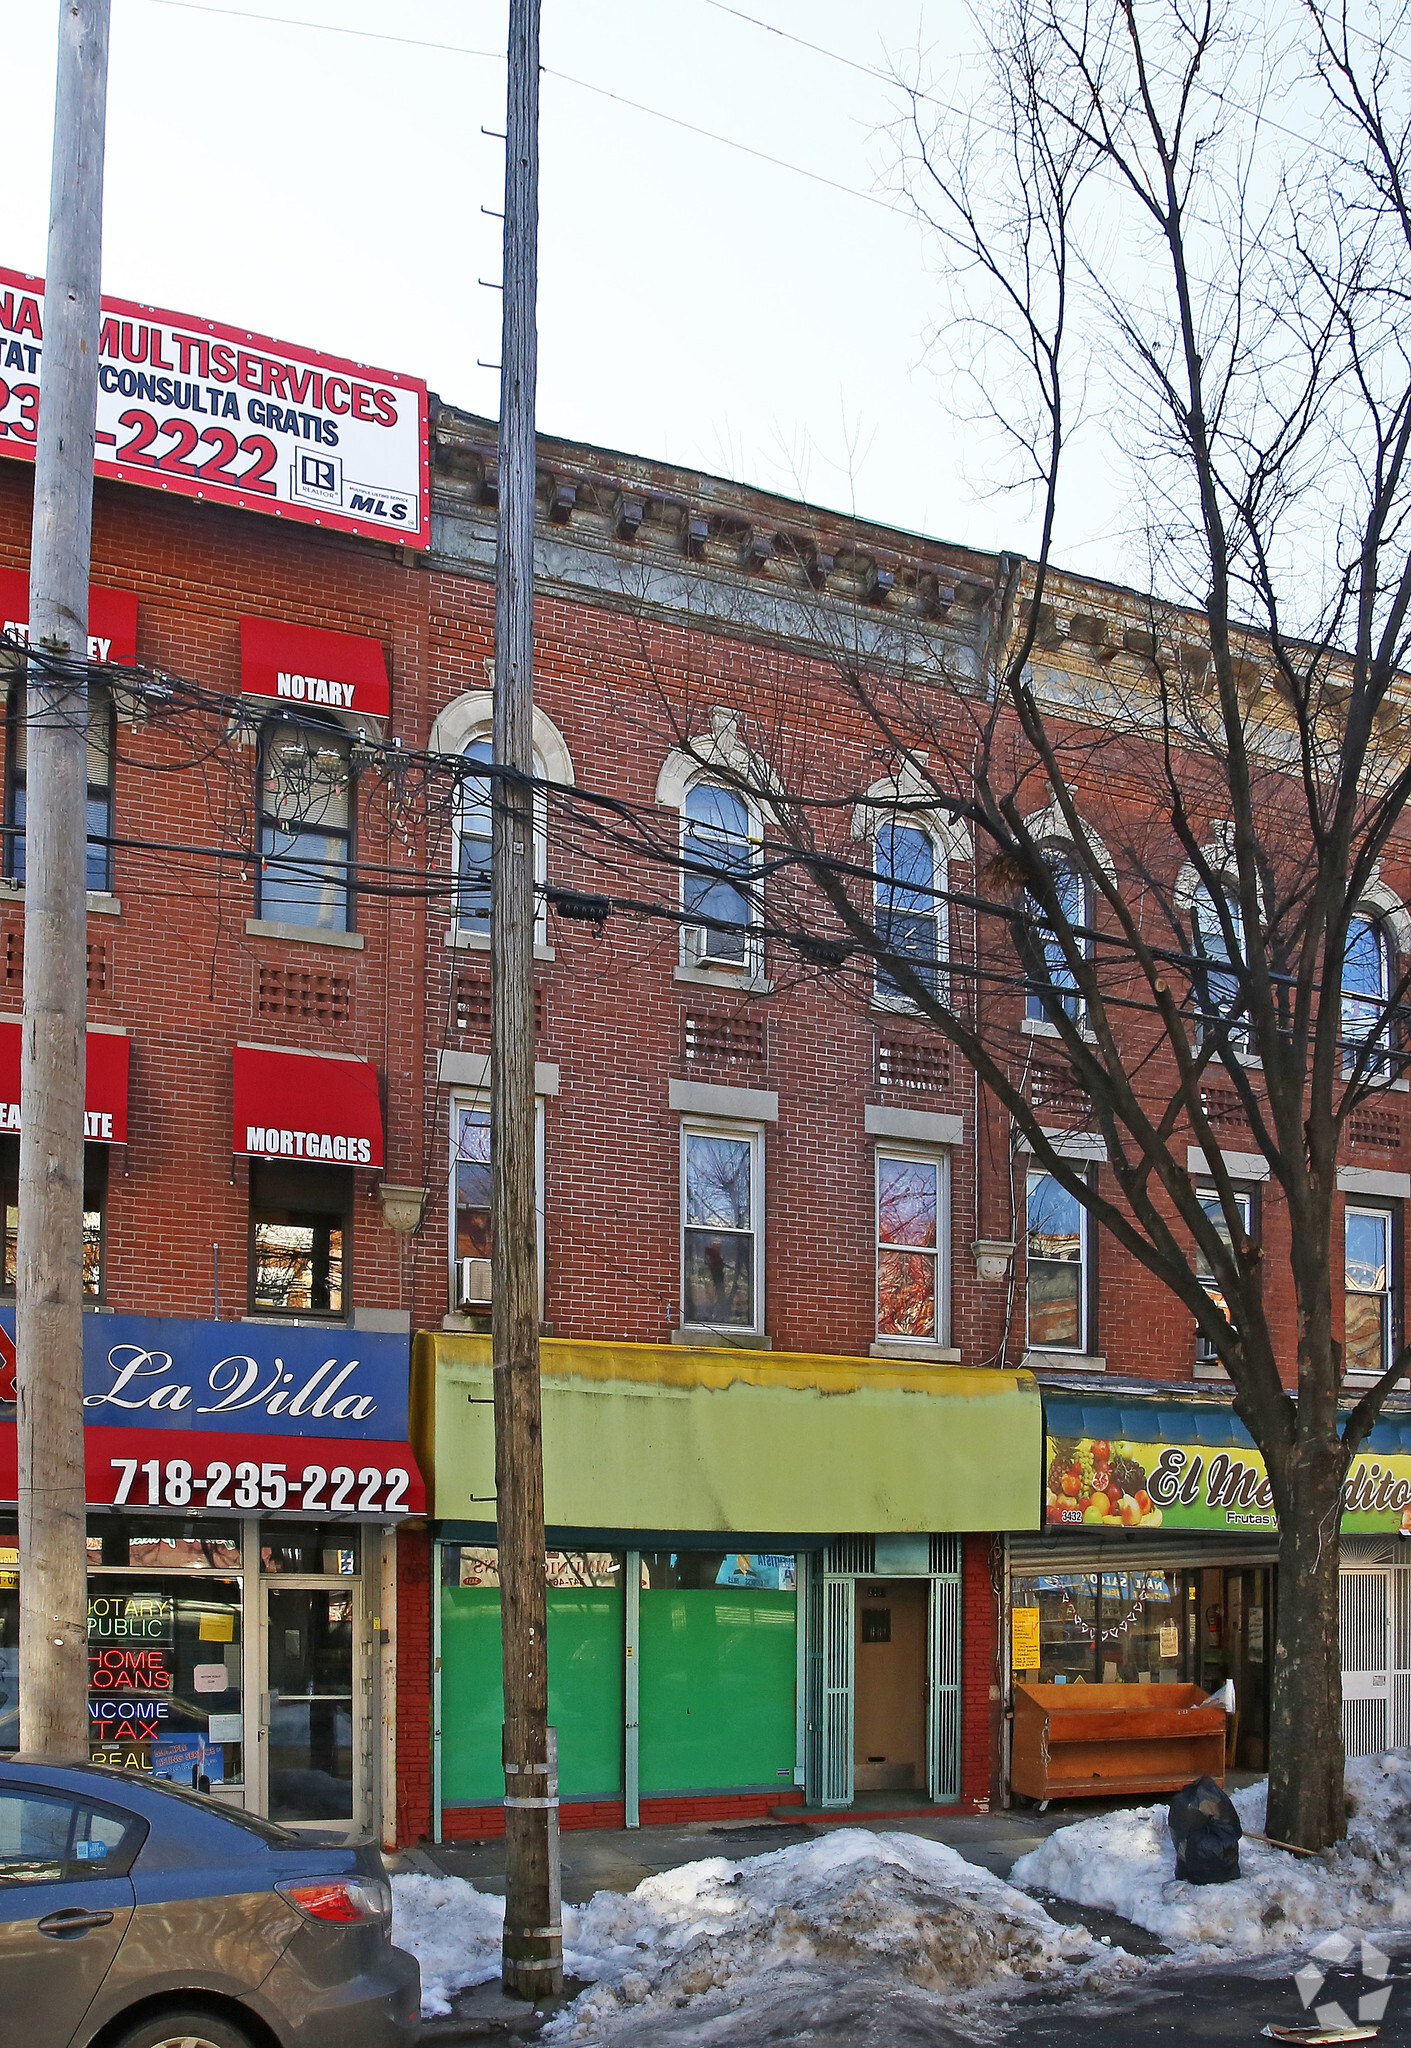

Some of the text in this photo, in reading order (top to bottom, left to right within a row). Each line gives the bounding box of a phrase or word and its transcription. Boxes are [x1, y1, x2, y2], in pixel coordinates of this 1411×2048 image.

[248, 398, 339, 447] GRATIS
[349, 493, 408, 520] MLS
[277, 671, 356, 709] NOTARY
[246, 1126, 371, 1164] MORTGAGES
[83, 1344, 378, 1421] La Villa
[110, 1458, 411, 1513] 718-235-2222
[1147, 1447, 1203, 1506] El
[1061, 1511, 1082, 1523] 3432
[1226, 1511, 1270, 1526] Frutas
[87, 1617, 163, 1638] PUBLIC
[87, 1669, 171, 1689] OANS
[88, 1702, 169, 1718] NCOME
[91, 1720, 160, 1740] TAX
